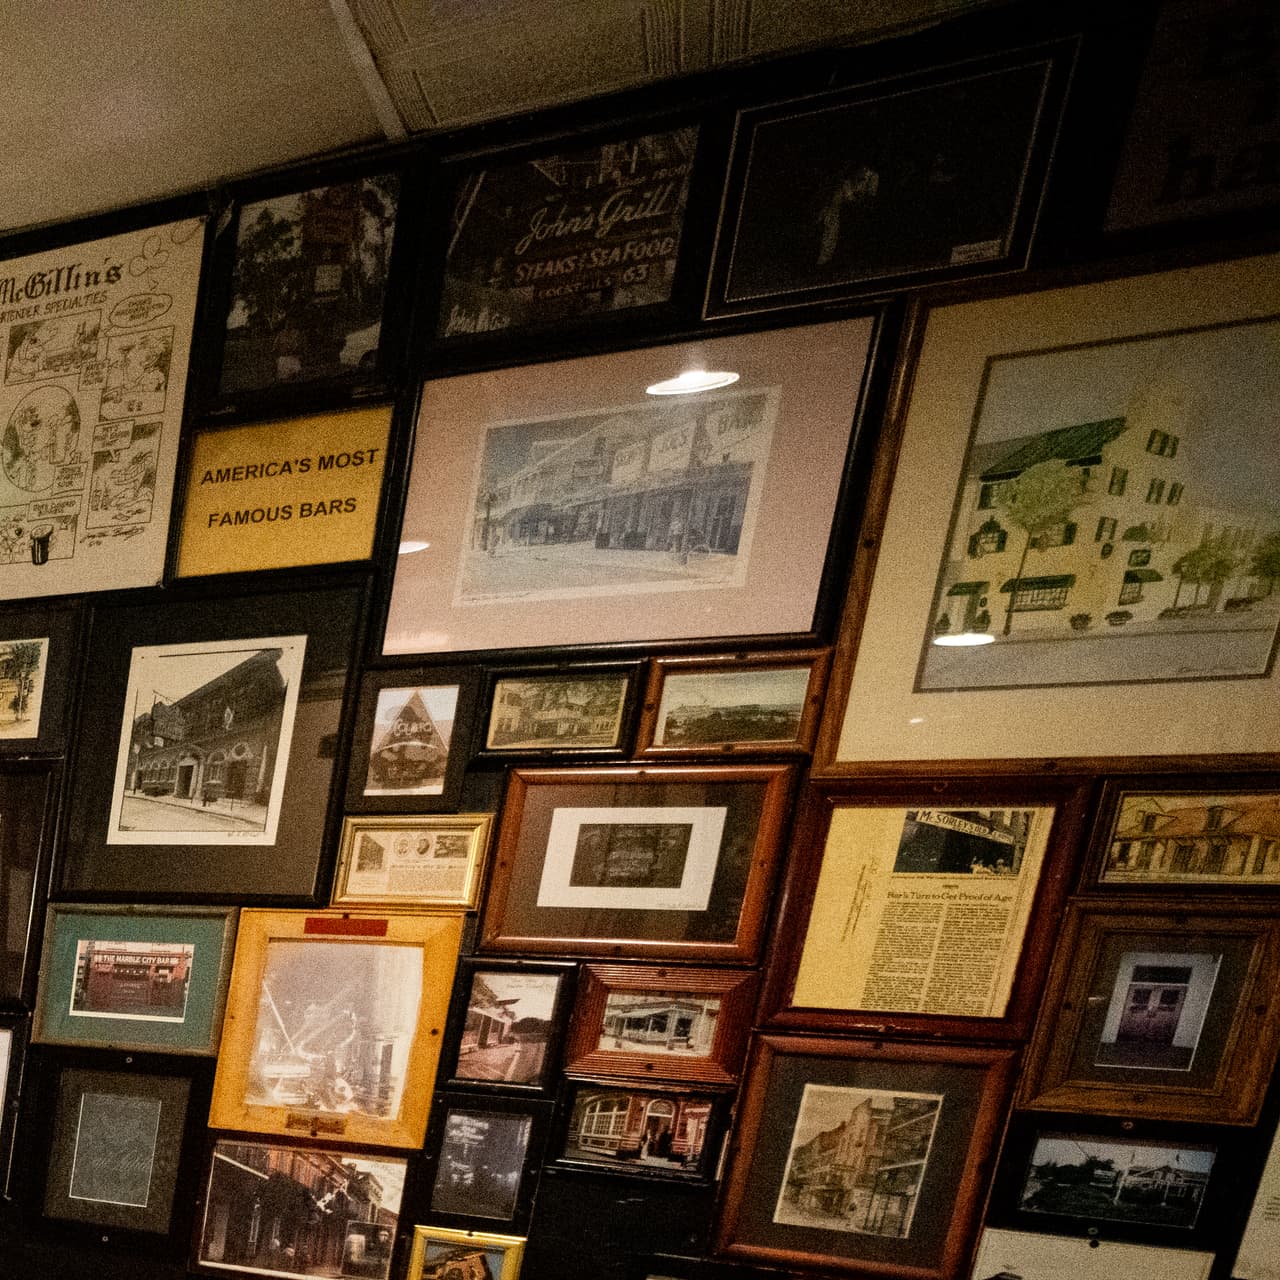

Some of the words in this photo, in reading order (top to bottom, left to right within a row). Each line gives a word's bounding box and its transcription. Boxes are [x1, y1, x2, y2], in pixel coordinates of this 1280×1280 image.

[514, 203, 596, 256] John's
[595, 182, 675, 239] Grill
[514, 255, 578, 281] STEAKS
[43, 291, 108, 316] SPECIALTIES
[201, 457, 312, 486] AMERICA'S
[317, 448, 379, 472] MOST
[207, 505, 293, 529] FAMOUS
[299, 497, 357, 519] BARS
[909, 891, 931, 900] Turn
[941, 892, 958, 900] Get
[958, 892, 981, 900] Proof
[993, 893, 1013, 902] Age
[142, 955, 155, 965] CITY
